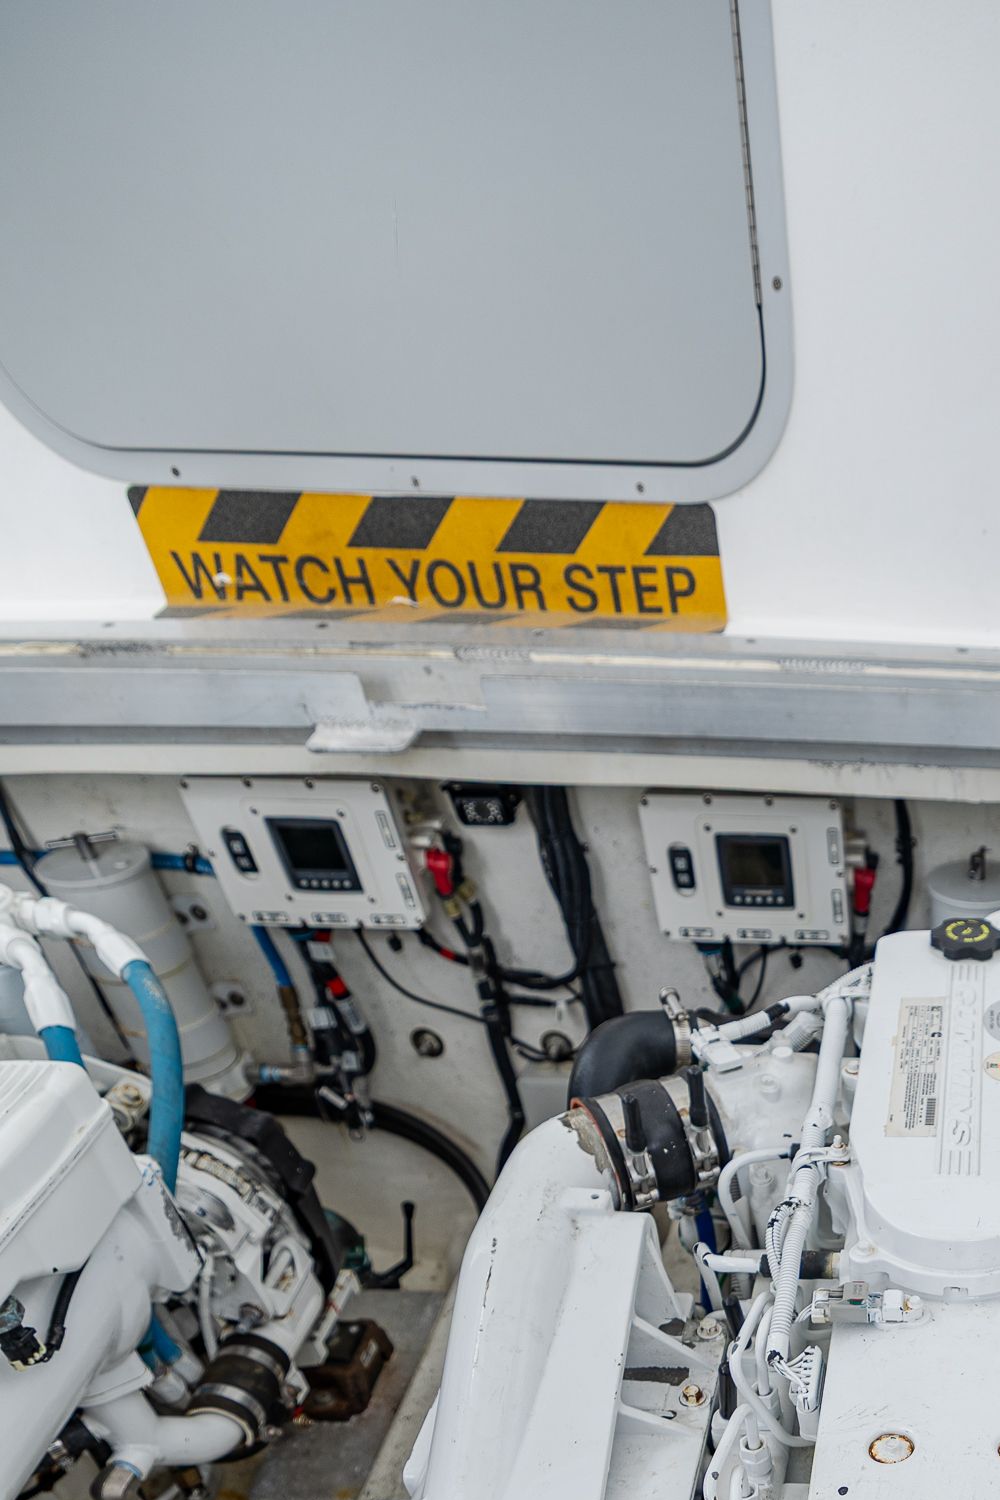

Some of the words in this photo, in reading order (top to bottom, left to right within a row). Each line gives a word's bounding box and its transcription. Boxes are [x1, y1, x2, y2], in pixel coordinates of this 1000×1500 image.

[169, 551, 376, 605] WATCH
[386, 558, 548, 610] YOUR
[565, 563, 697, 614] STEP
